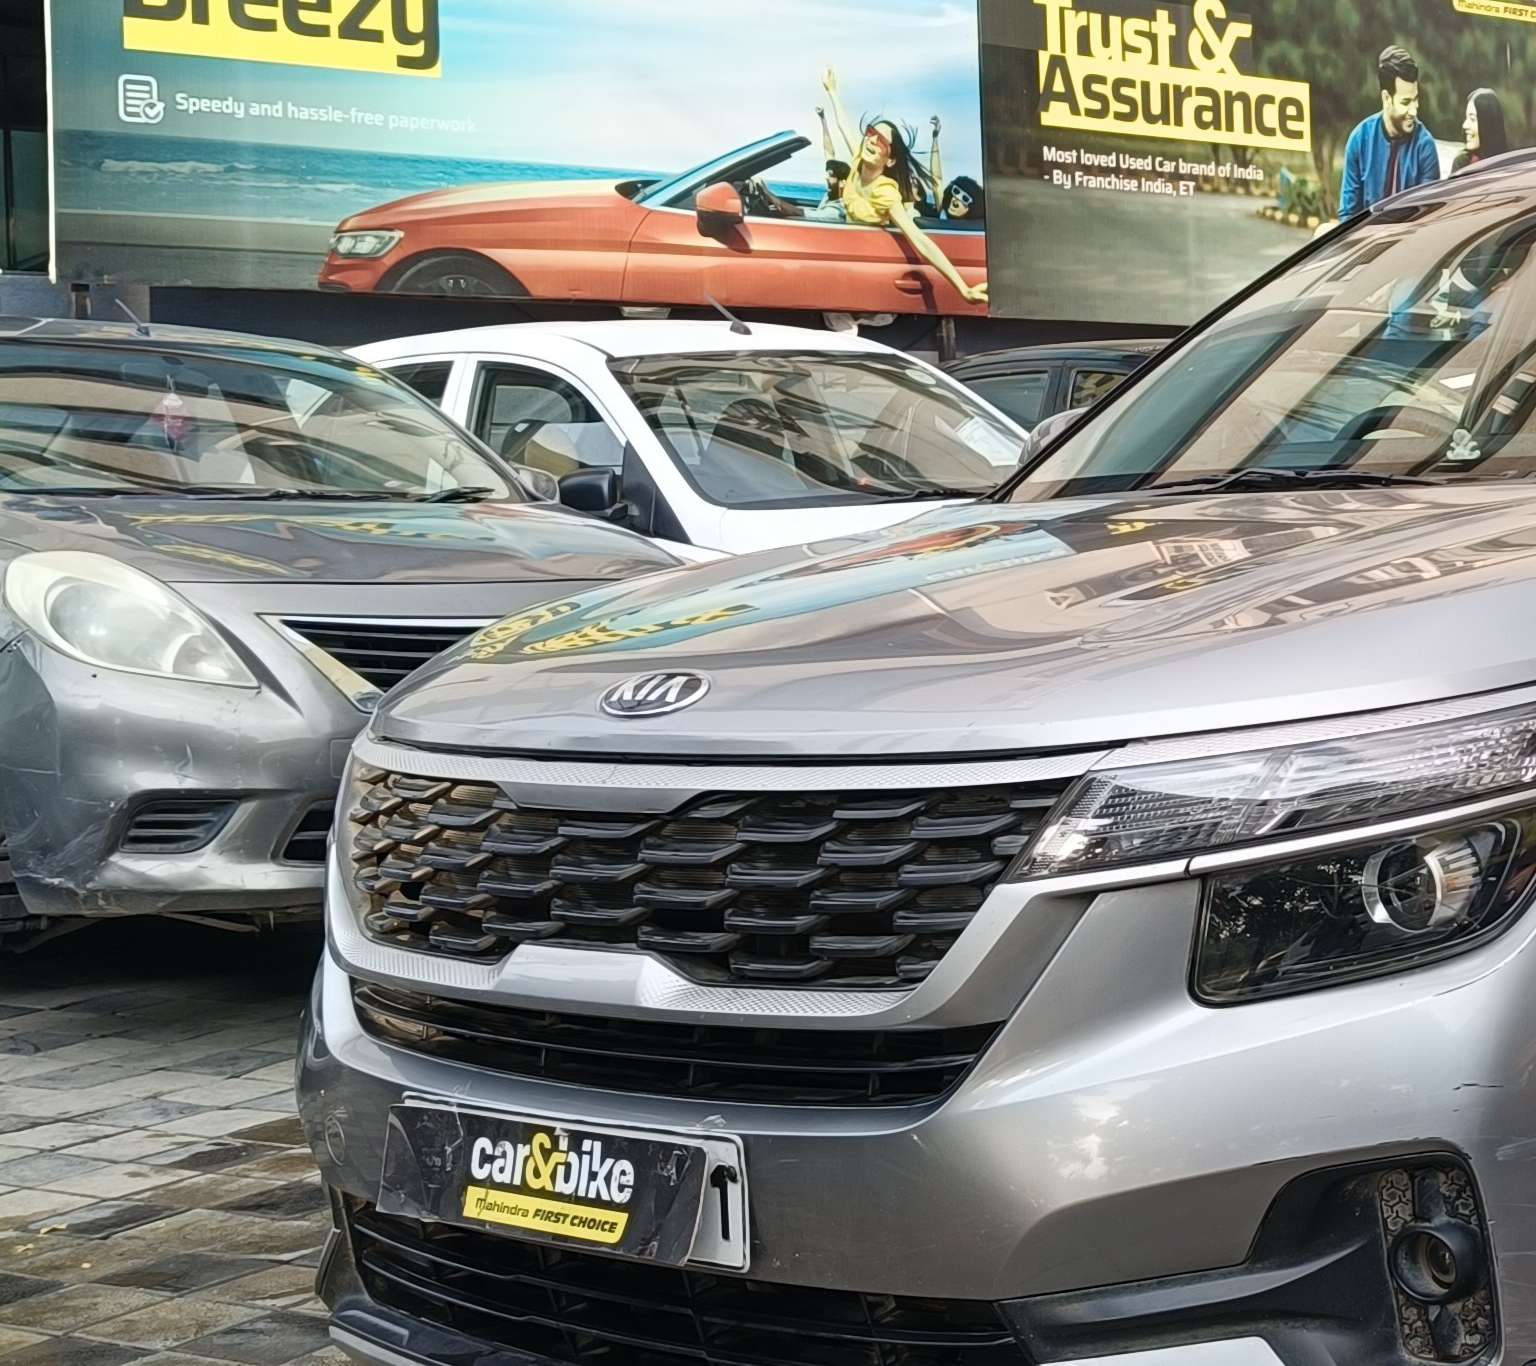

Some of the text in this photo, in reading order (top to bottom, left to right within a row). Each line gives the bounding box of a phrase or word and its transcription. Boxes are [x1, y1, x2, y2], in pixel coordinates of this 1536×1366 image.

[1458, 0, 1501, 13] Mahindra
[1503, 6, 1529, 17] FIRST
[175, 91, 477, 134] Speedy and hassle-free paperwork
[1038, 53, 1305, 140] Assurance
[1043, 146, 1264, 180] Most loved Used Car brand of India
[1053, 170, 1072, 189] By
[1075, 171, 1139, 192] Franchise
[1141, 178, 1178, 197] India,
[1179, 182, 1196, 196] ET
[609, 674, 690, 702] KIA
[470, 1132, 635, 1204] car&bike
[475, 1197, 619, 1234] Mahindra FIRST CHOICE
